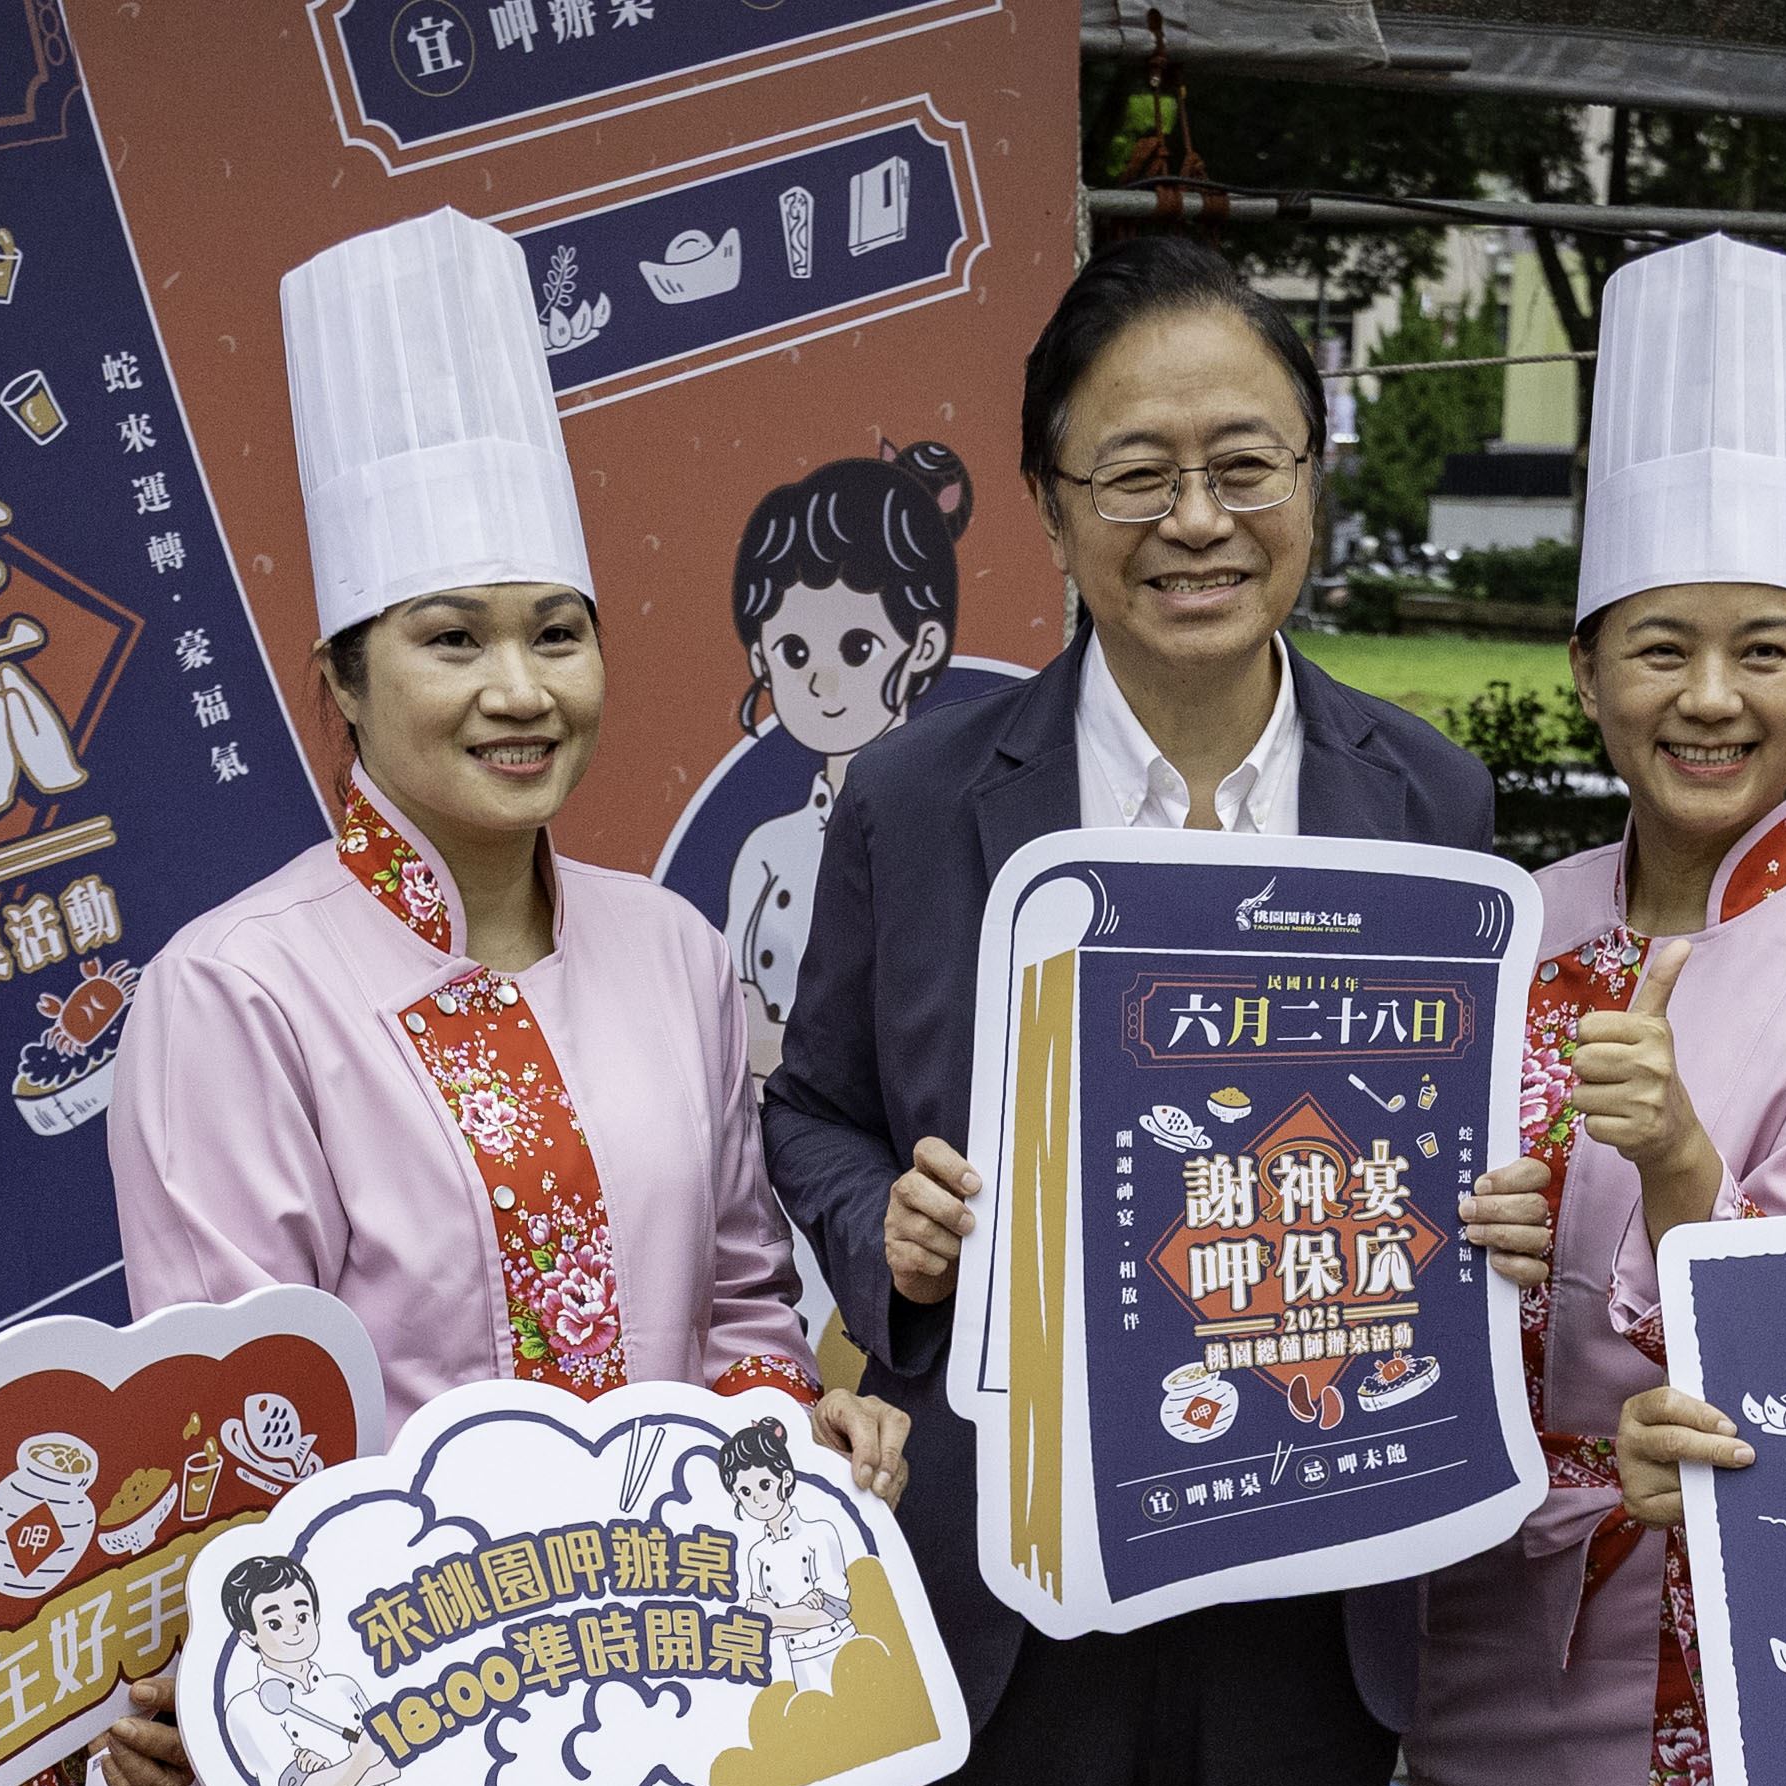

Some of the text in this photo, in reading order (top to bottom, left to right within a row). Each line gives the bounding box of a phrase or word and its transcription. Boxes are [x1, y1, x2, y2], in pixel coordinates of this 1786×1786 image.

[407, 16, 464, 77] 宜
[1253, 909, 1362, 927] 桃園閩南文化節
[1167, 992, 1449, 1051] 六月二十八日
[1182, 1138, 1412, 1230] 謝神宴
[1283, 1304, 1341, 1334] 2025
[1301, 1442, 1409, 1484] 忌 呷未飽
[1148, 1471, 1262, 1516] 宜 呷辦桌
[356, 1525, 733, 1671] 來桃園呷辦桌
[369, 1606, 768, 1762] 18:00準時開桌
